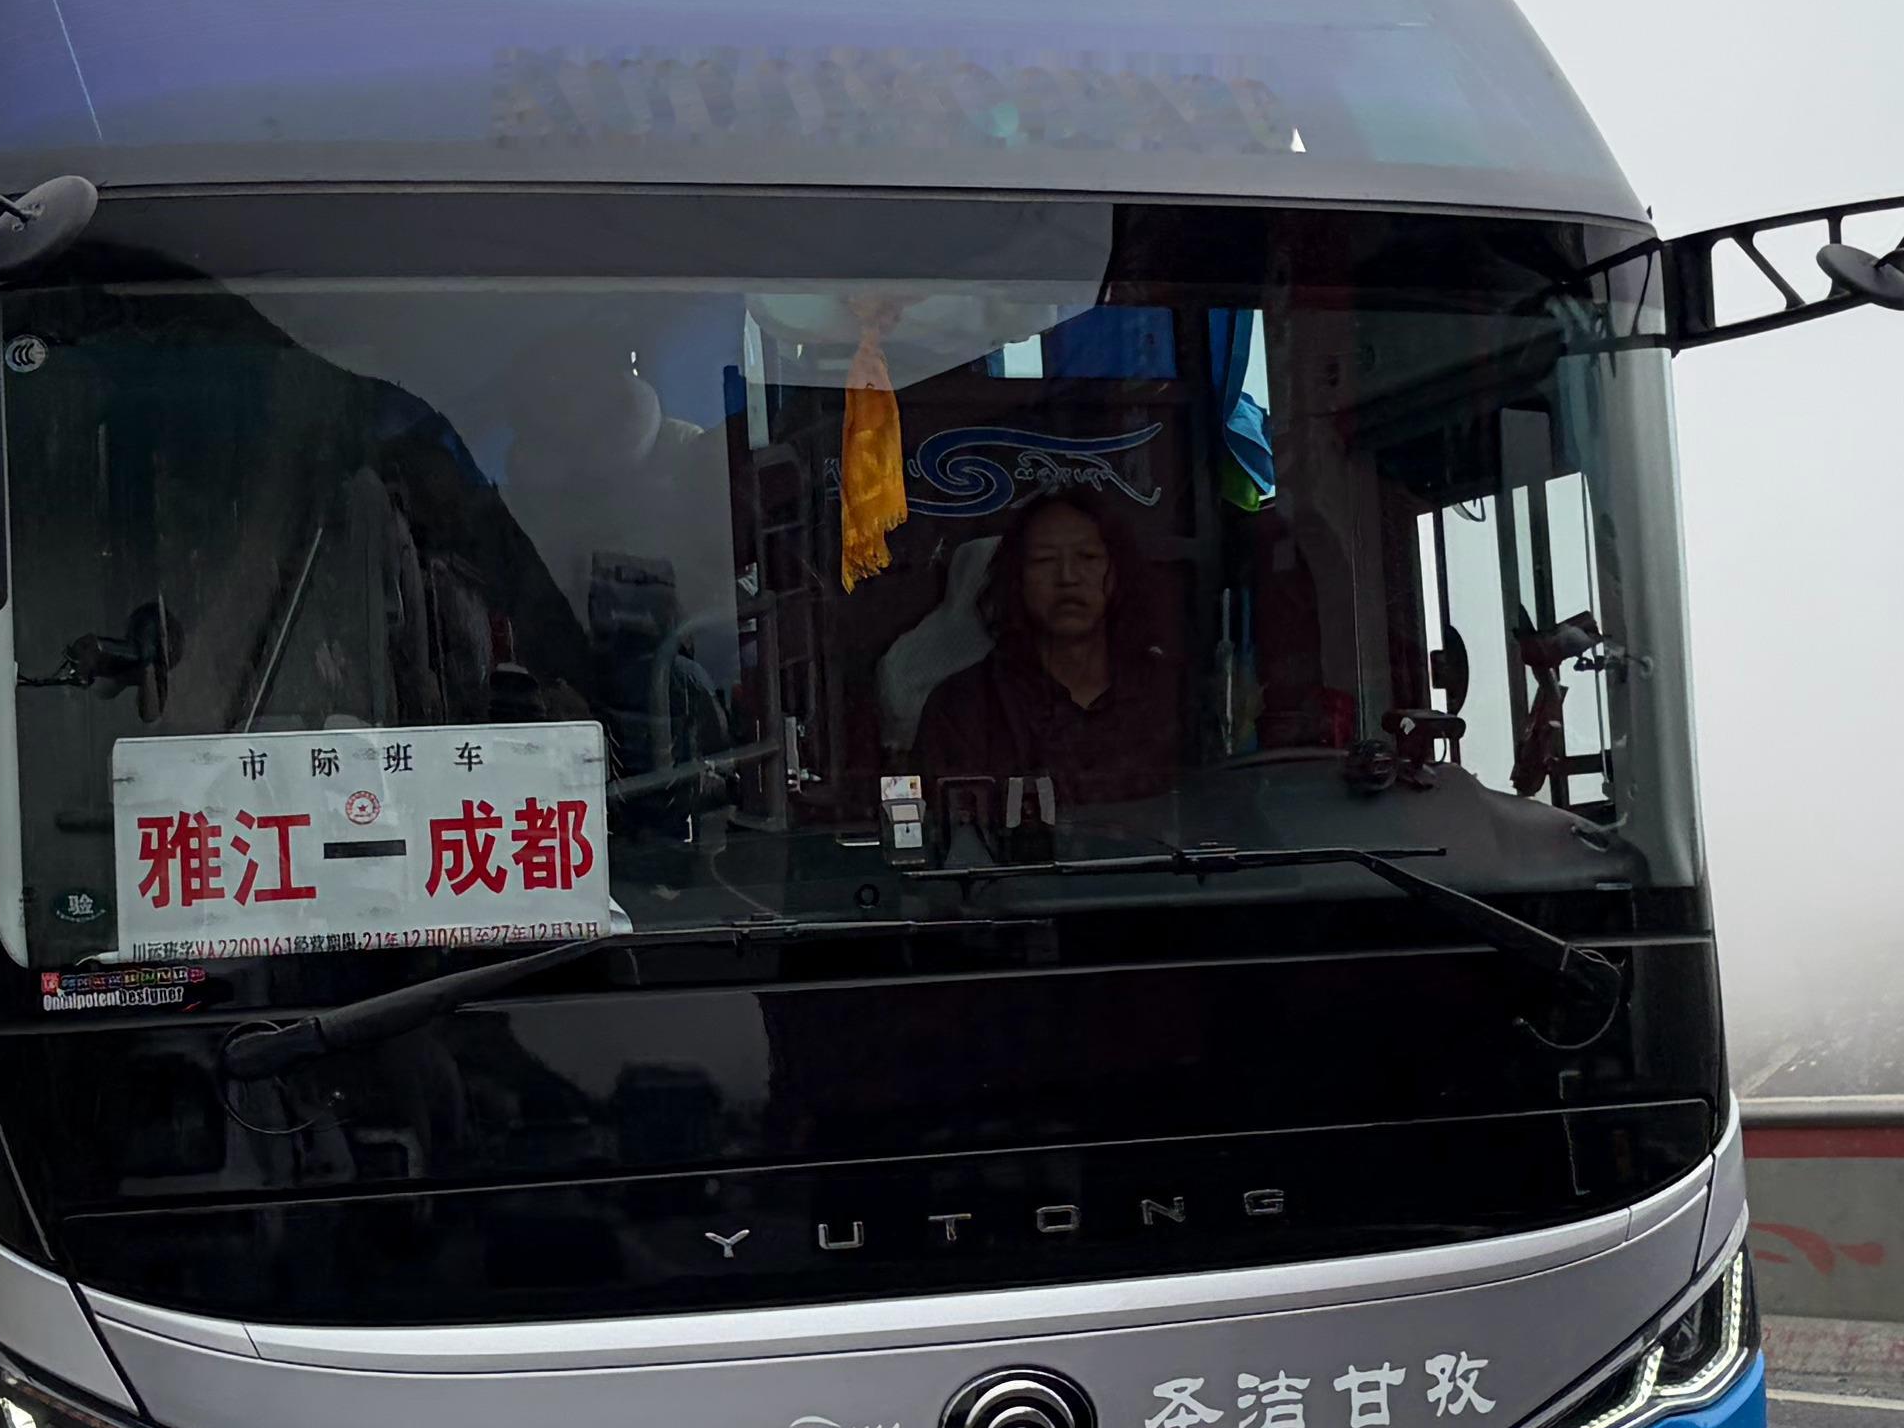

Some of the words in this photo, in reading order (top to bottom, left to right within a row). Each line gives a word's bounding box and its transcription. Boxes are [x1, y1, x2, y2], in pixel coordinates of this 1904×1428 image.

[239, 741, 484, 780] 市际班车
[67, 893, 94, 915] 验
[704, 1188, 1285, 1258] YUTONG
